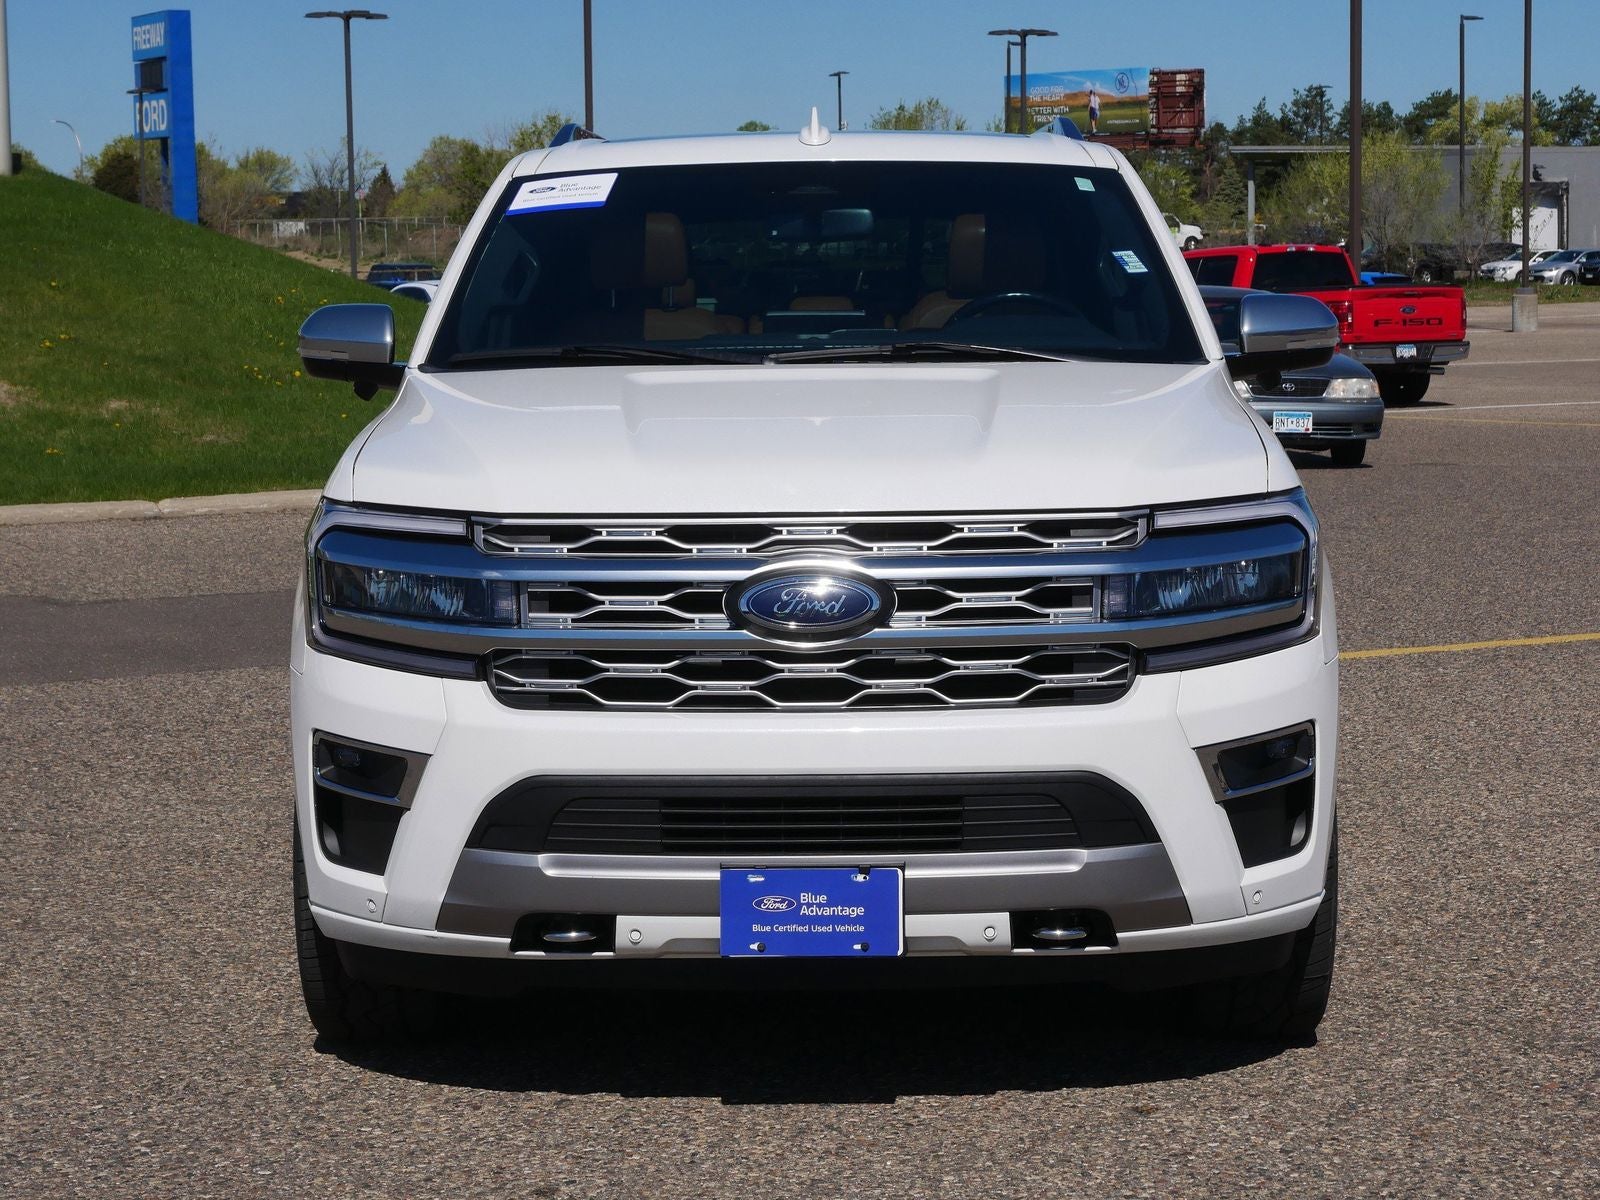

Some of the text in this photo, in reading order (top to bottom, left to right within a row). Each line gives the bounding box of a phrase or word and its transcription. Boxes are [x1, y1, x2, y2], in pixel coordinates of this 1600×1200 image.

[133, 22, 165, 50] FREEWAY
[1030, 86, 1048, 94] GOOD
[1053, 105, 1069, 114] WITH
[1374, 317, 1444, 328] F-150
[774, 588, 847, 615] Ford
[761, 898, 788, 910] Ford
[800, 893, 827, 904] Blue
[800, 905, 865, 918] Advantage
[752, 924, 865, 932] Blue Certified Used Vehicle
